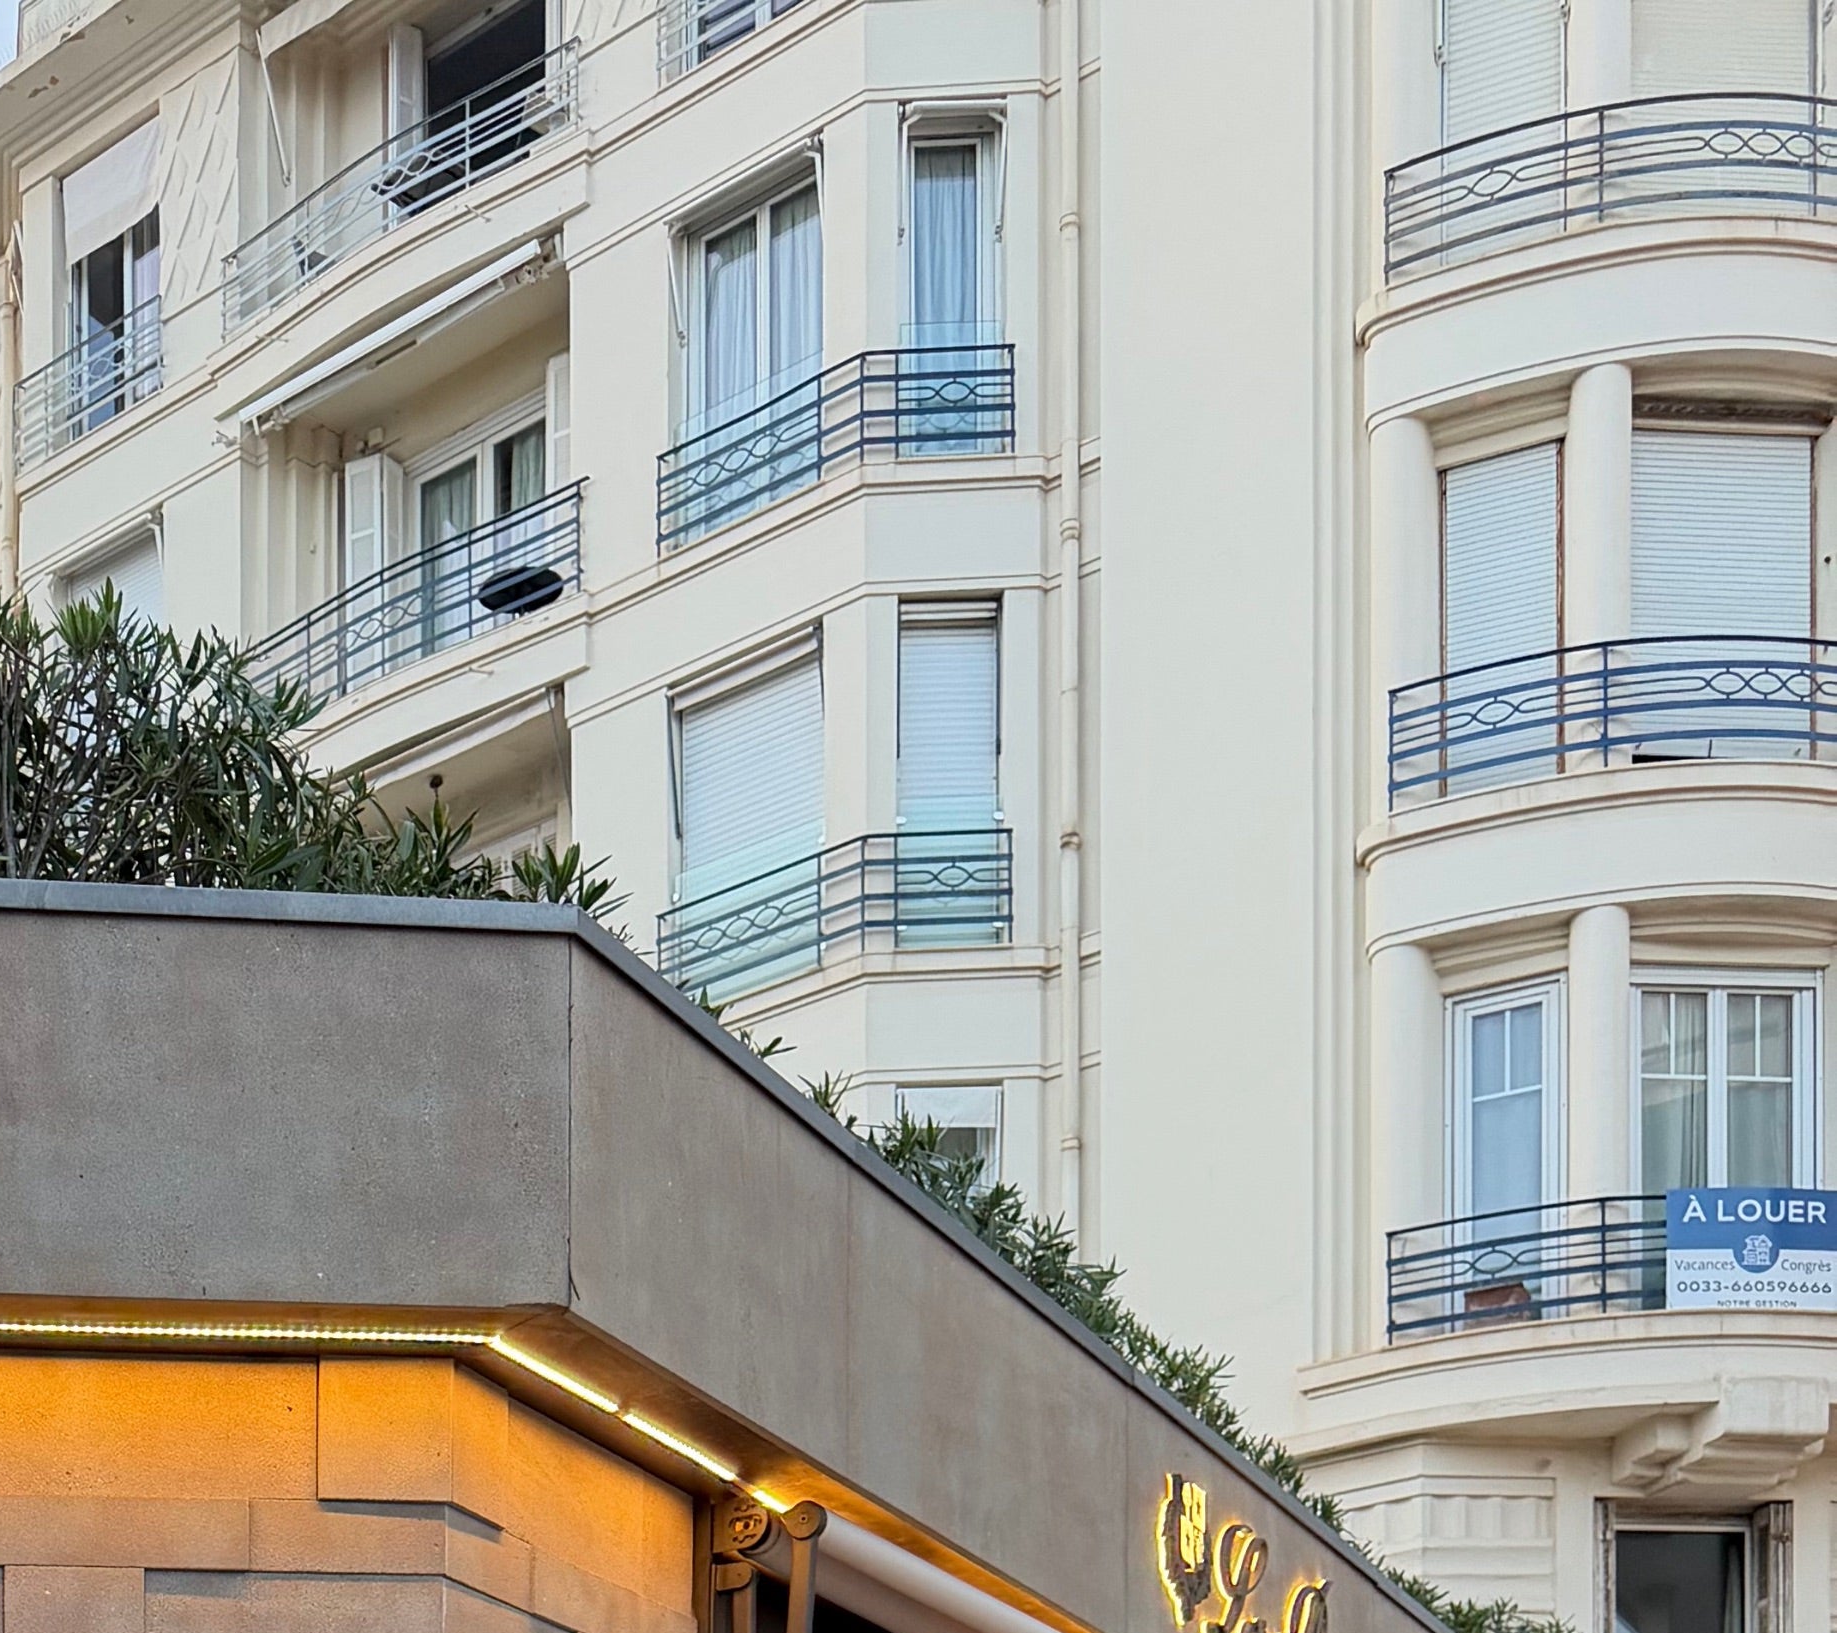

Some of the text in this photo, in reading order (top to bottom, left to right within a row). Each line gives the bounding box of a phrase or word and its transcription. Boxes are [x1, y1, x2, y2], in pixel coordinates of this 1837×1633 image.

[1682, 1195, 1827, 1224] À LOUER
[1674, 1258, 1832, 1275] Vacances Congrès
[1676, 1280, 1833, 1294] 0033-660596666
